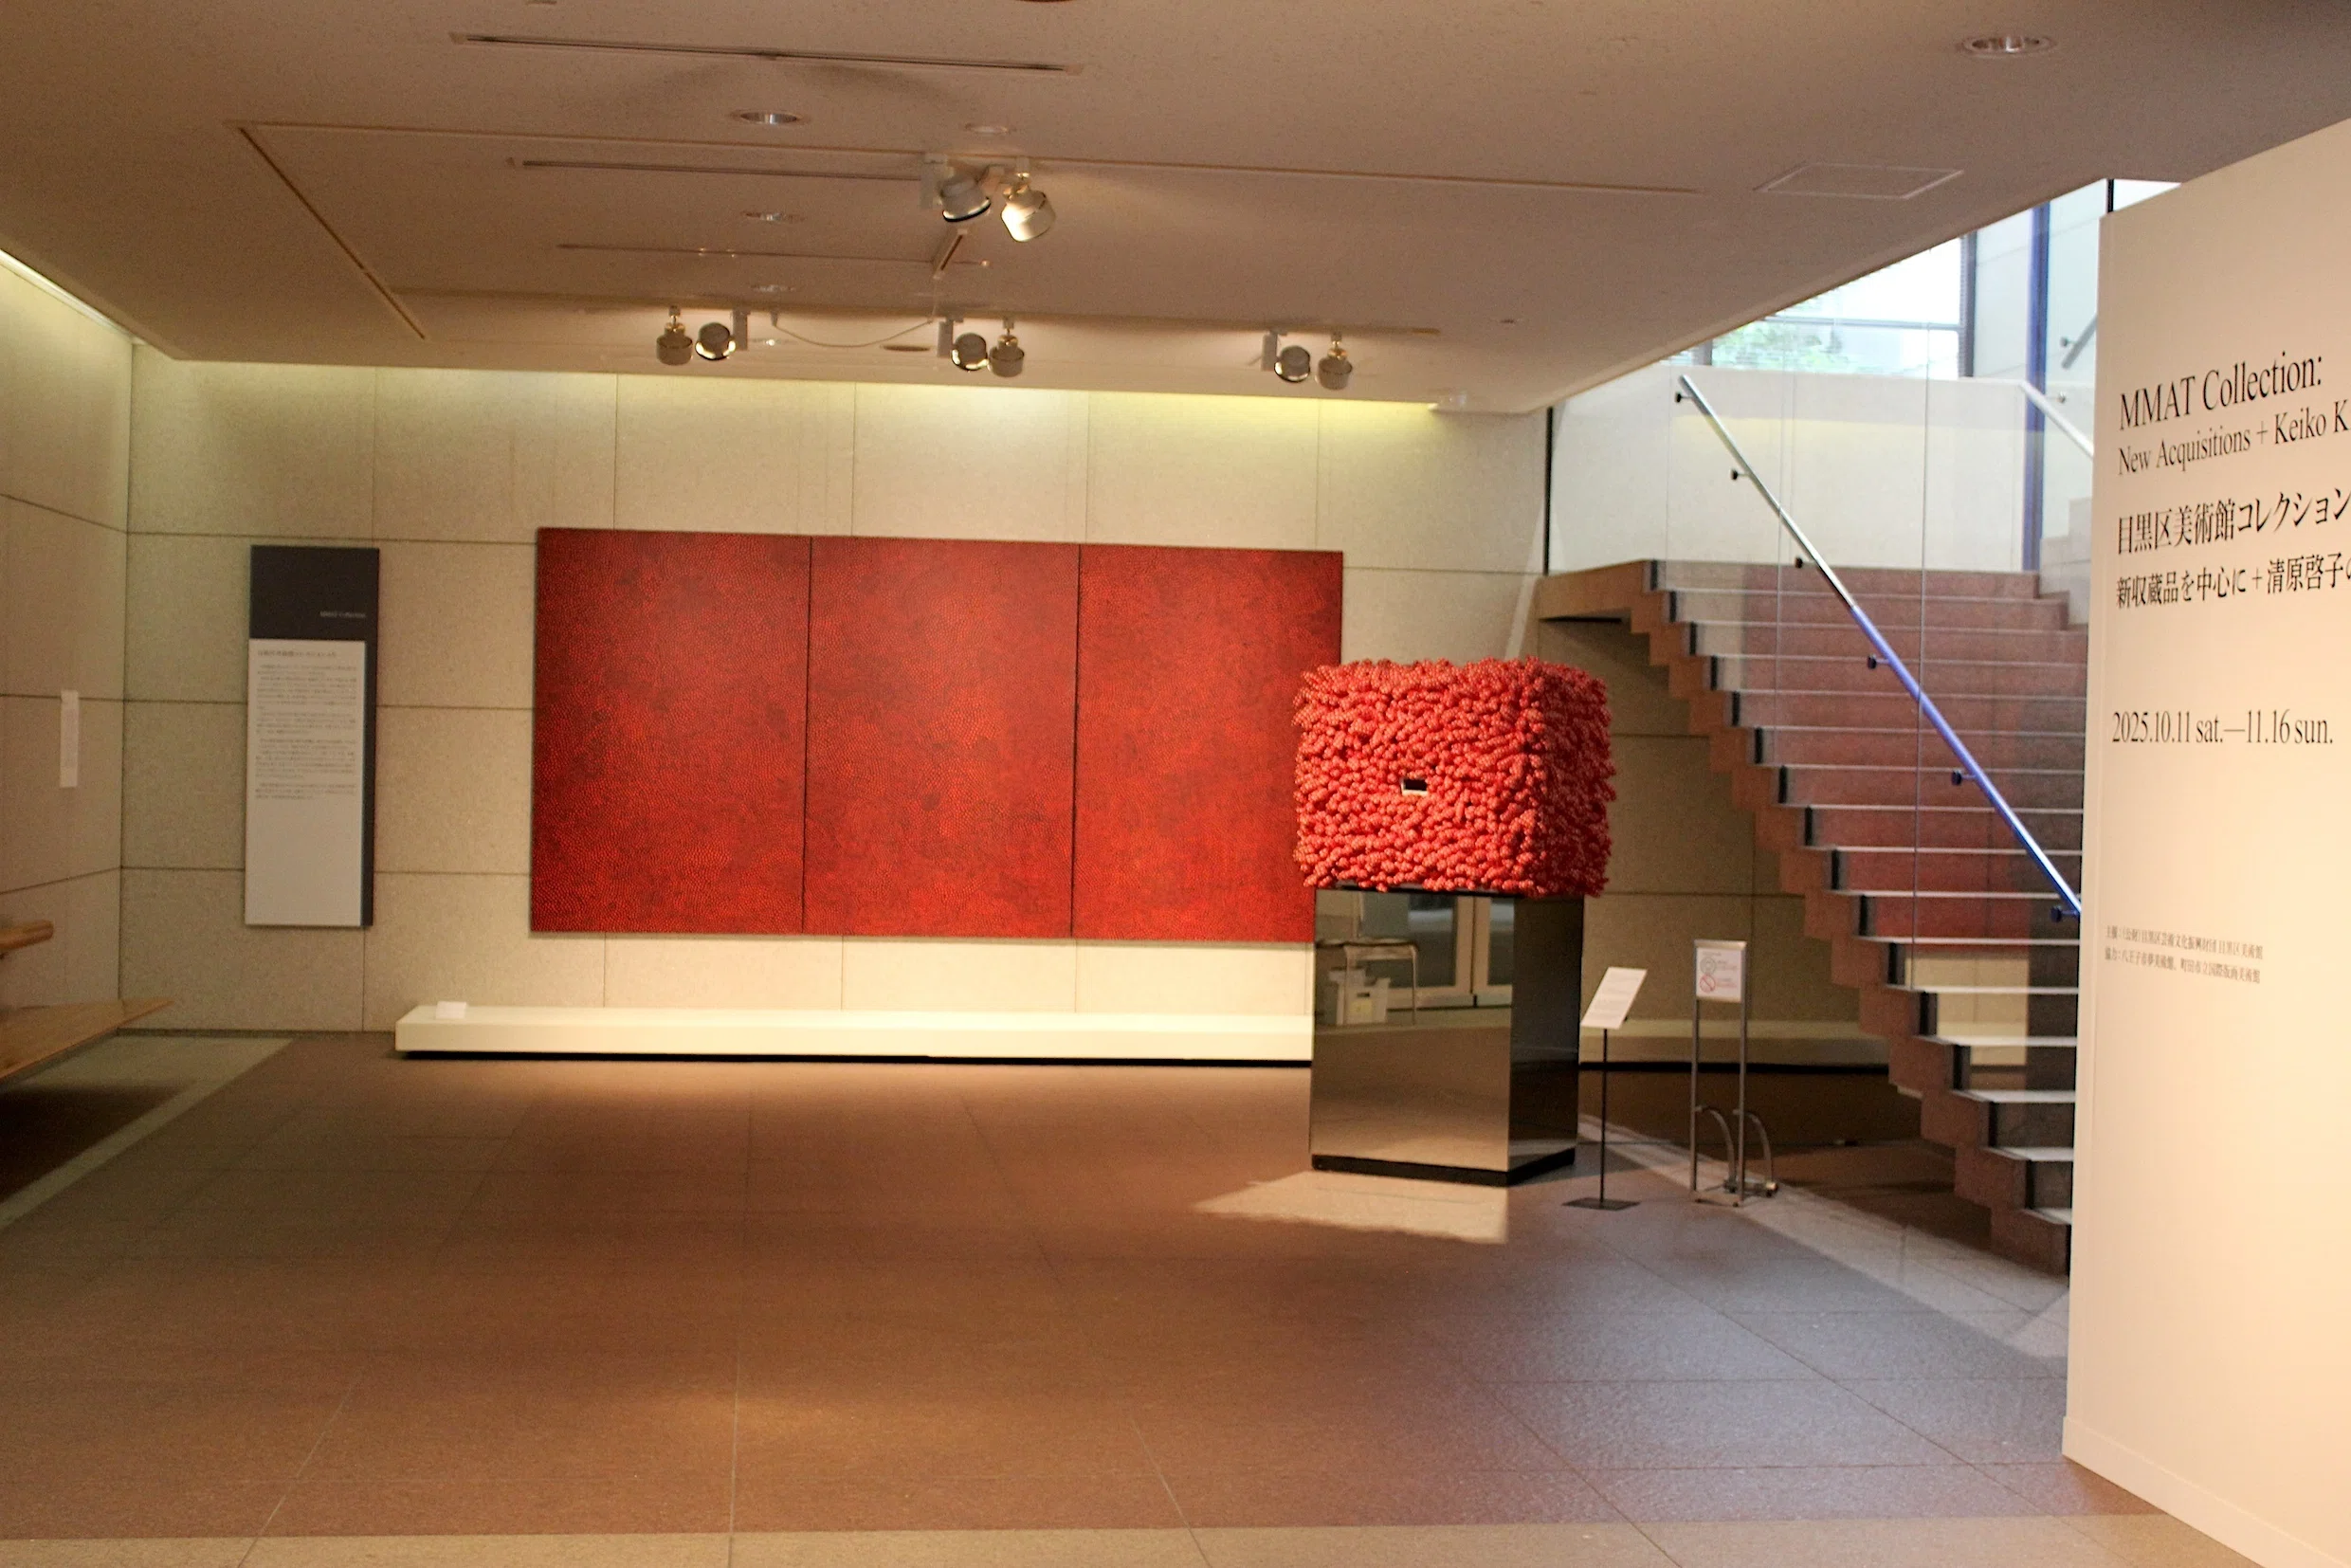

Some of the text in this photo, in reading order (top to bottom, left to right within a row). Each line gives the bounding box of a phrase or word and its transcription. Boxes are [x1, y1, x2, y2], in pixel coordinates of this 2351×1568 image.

[2120, 351, 2323, 430] MMAT Collection:
[2118, 398, 2351, 476] New Acquisitions + Keiko K
[2118, 487, 2351, 556] 目黒区美術館コレクション
[2112, 710, 2191, 743] 2025.10.11
[2294, 719, 2334, 744] sun.
